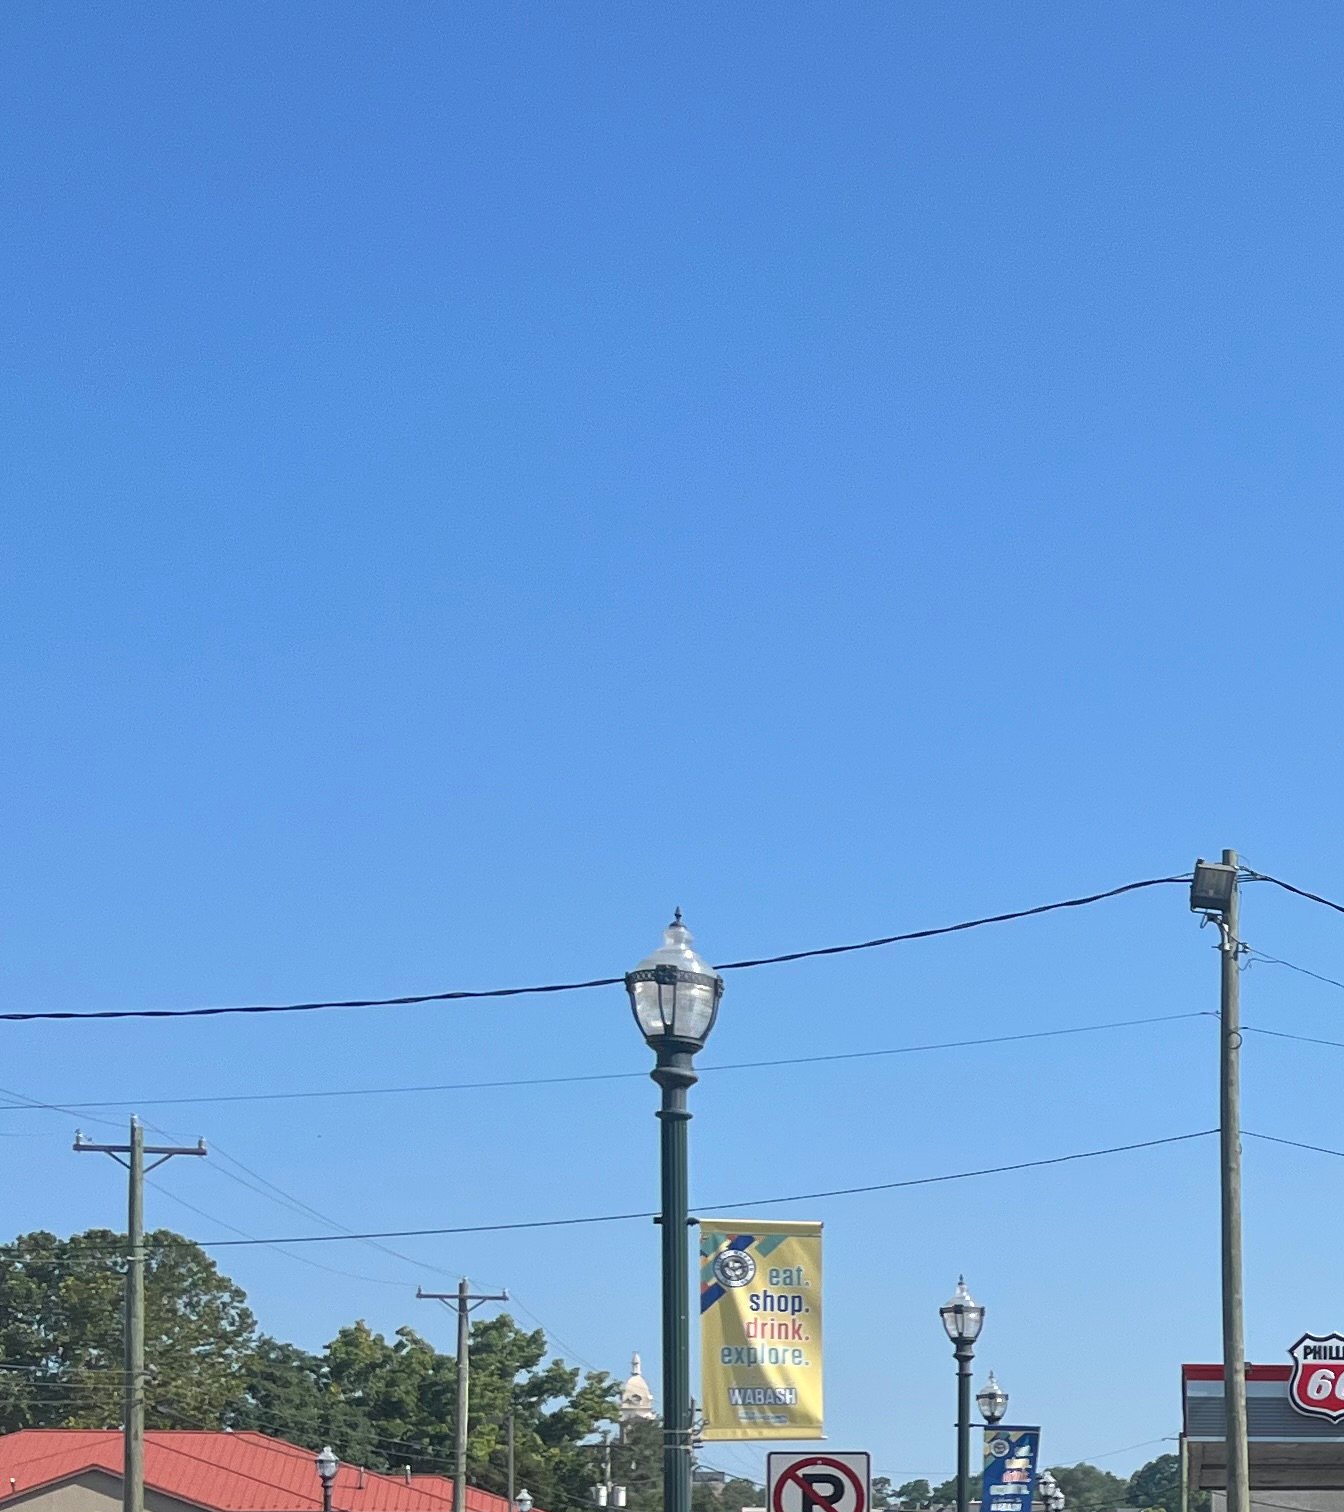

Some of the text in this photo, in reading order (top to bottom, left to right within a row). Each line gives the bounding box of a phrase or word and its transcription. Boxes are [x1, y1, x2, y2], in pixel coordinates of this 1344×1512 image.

[769, 1266, 810, 1286] eat.
[750, 1290, 810, 1316] shop.
[746, 1318, 810, 1340] drink.
[721, 1344, 810, 1367] explore.
[729, 1387, 797, 1405] WABASH
